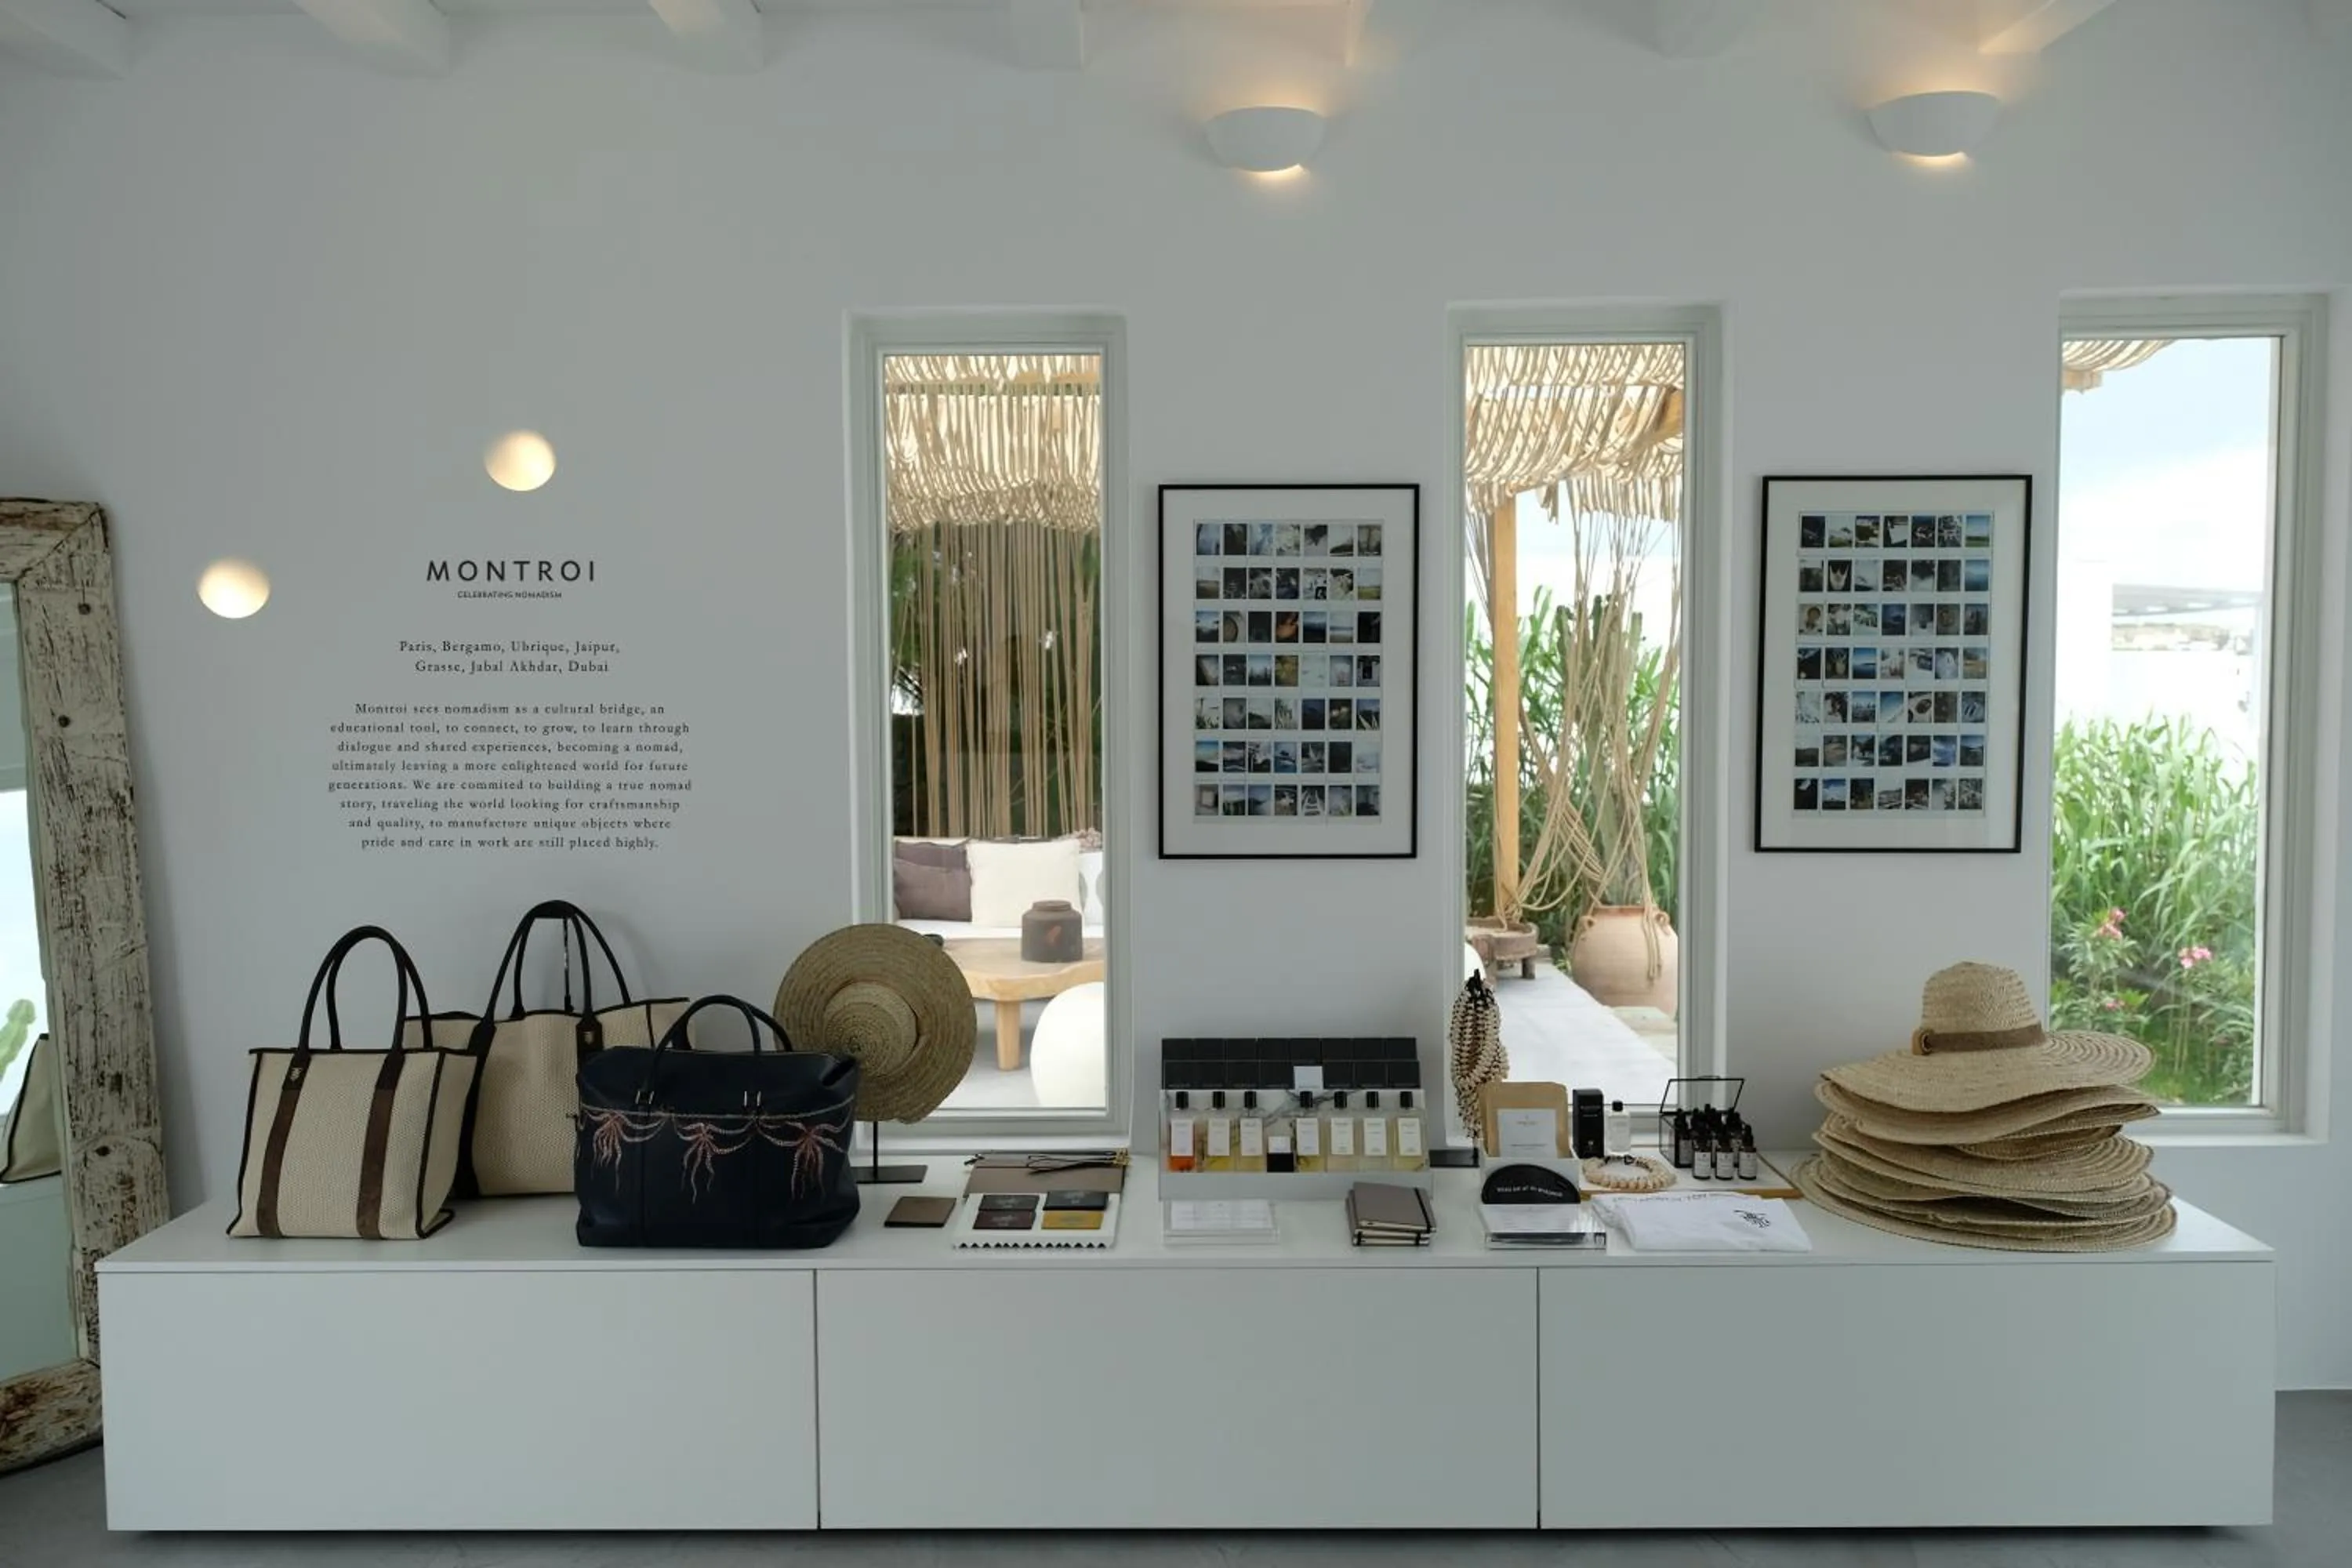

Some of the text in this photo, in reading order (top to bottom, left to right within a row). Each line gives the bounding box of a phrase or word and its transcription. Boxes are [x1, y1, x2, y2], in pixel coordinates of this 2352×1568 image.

[426, 560, 594, 583] MONTROI
[399, 640, 619, 656] Paris, Bergamo, Ubrique, Jaipur,
[415, 660, 608, 674] Grasse, Jabal Akhdar, Dubai
[355, 703, 407, 713] Montroi
[445, 703, 509, 714] nomadism
[545, 703, 593, 714] cultural
[600, 702, 644, 717] bridge,
[331, 722, 403, 733] educational
[410, 722, 439, 734] tool,
[464, 724, 518, 734] connect,
[524, 724, 537, 734] to
[543, 725, 577, 735] grow,
[583, 724, 595, 733] to
[601, 722, 633, 733] learn
[639, 723, 688, 736] through
[337, 741, 391, 754] dialogue
[397, 742, 419, 752] and
[425, 741, 466, 752] shared
[472, 742, 551, 755] experiences,
[557, 741, 619, 754] becoming
[636, 742, 682, 753] nomad,
[332, 760, 395, 773] ultimately
[401, 760, 448, 773] leaving
[452, 763, 459, 771] a
[502, 760, 576, 773] enlightened
[583, 760, 619, 771] world
[624, 760, 644, 771] for
[649, 760, 688, 771] future
[328, 779, 407, 792] generations.
[412, 779, 430, 789] We
[460, 779, 523, 789] commited
[548, 779, 601, 793] building
[617, 782, 644, 790] true
[650, 779, 691, 790] nomad
[340, 797, 680, 813] story, traveling the world looking for craftsmanship
[349, 816, 371, 827] and
[377, 817, 424, 831] quality,
[448, 818, 527, 828] manufacture
[534, 818, 575, 831] unique
[581, 818, 628, 831] objects
[633, 818, 670, 829] where
[361, 836, 394, 850] pride
[401, 836, 423, 848] and
[460, 837, 472, 848] in
[477, 837, 509, 847] work
[539, 837, 564, 847] still
[569, 837, 610, 850] placed
[615, 837, 659, 850] highly.
